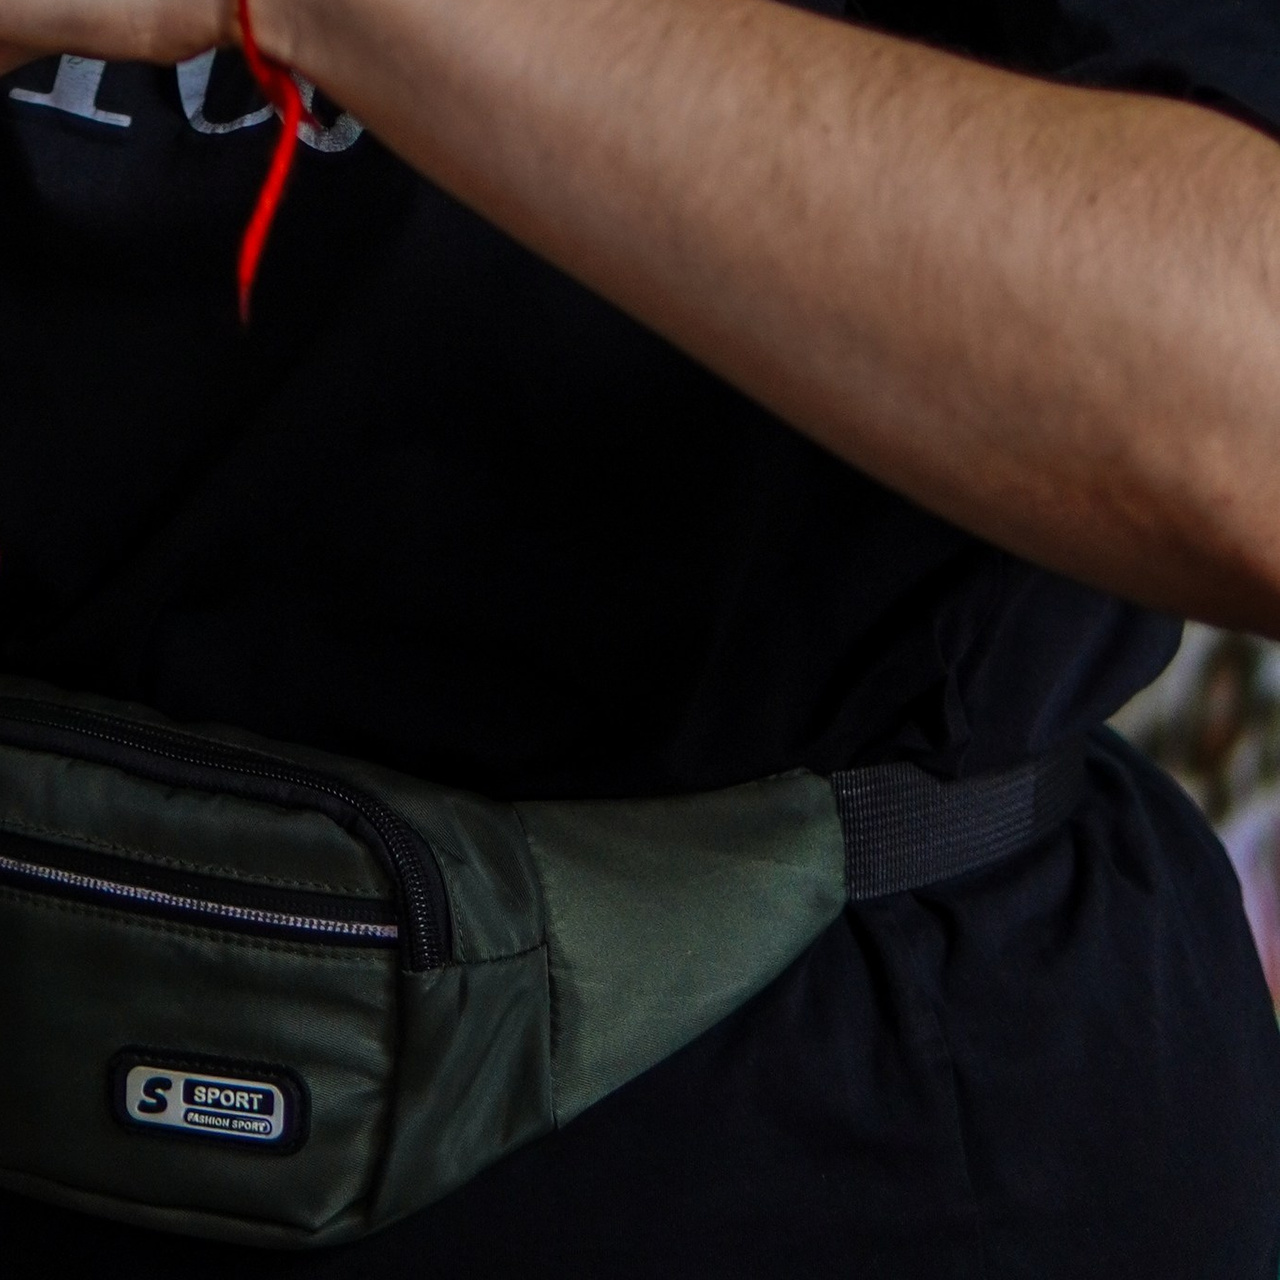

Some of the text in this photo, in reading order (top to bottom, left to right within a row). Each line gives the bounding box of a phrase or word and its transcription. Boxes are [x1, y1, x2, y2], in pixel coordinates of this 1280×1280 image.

[136, 1075, 173, 1114] S
[193, 1085, 263, 1111] SPORT
[186, 1112, 267, 1133] FASHION SPORT
